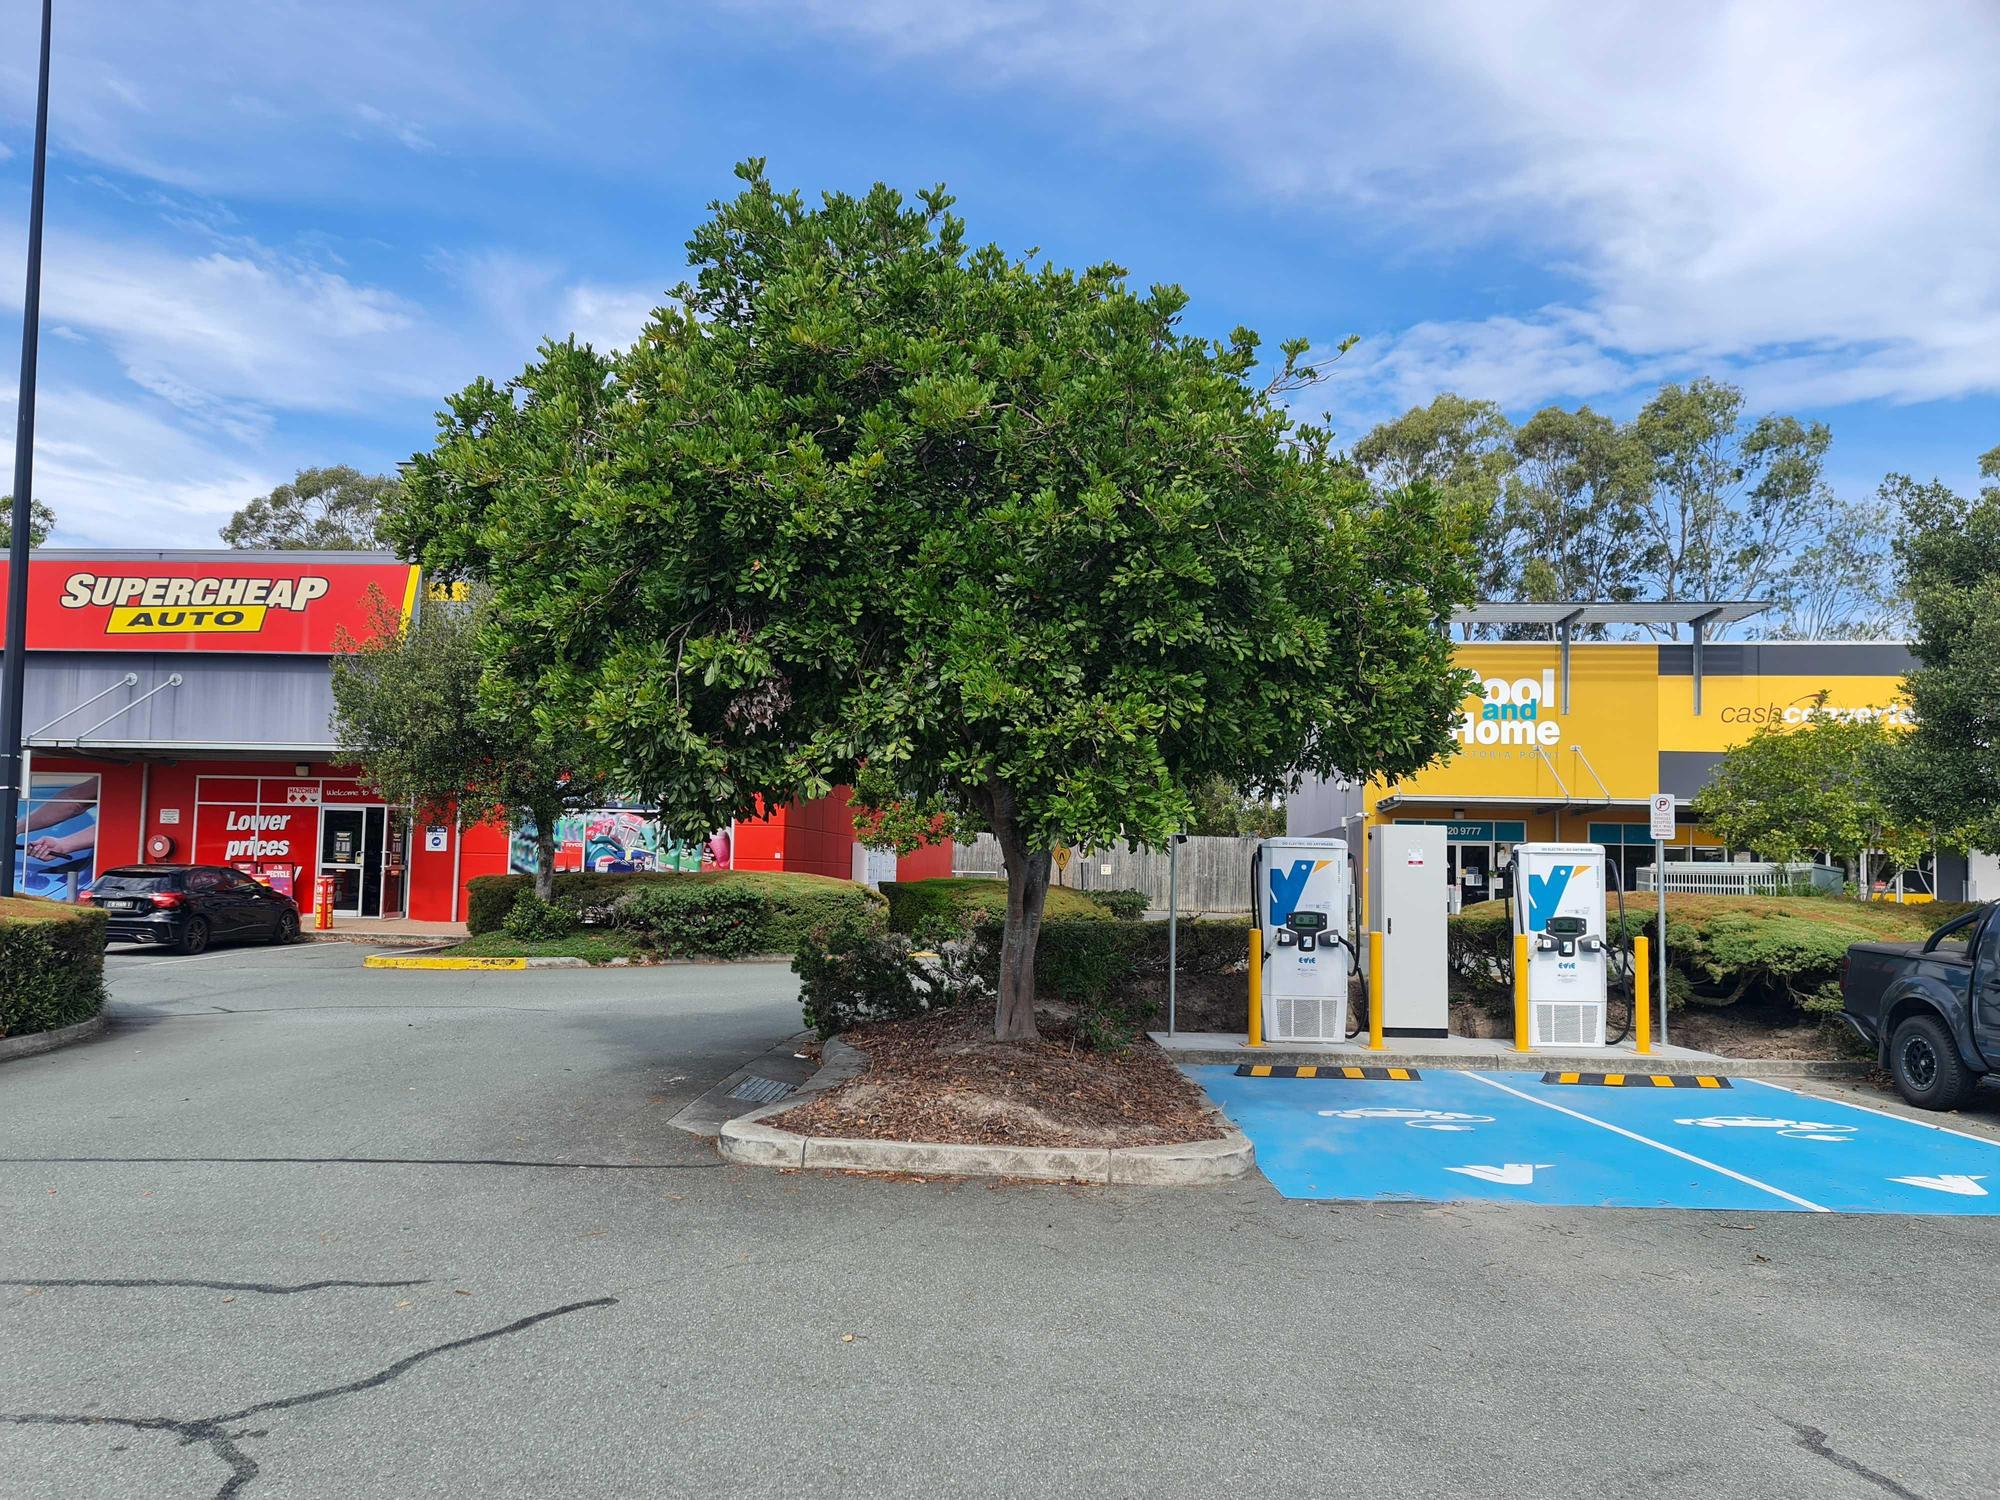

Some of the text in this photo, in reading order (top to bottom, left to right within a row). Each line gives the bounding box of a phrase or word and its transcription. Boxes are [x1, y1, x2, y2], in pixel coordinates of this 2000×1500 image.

[60, 572, 330, 612] SUPERCHEAP
[126, 611, 245, 627] AUTO
[1449, 668, 1555, 708] ool
[1482, 698, 1537, 721] and
[1721, 702, 1783, 724] cash
[288, 786, 320, 794] HAZCHEM
[225, 810, 291, 831] Lower
[1460, 826, 1482, 836] 9777
[224, 836, 290, 861] prices
